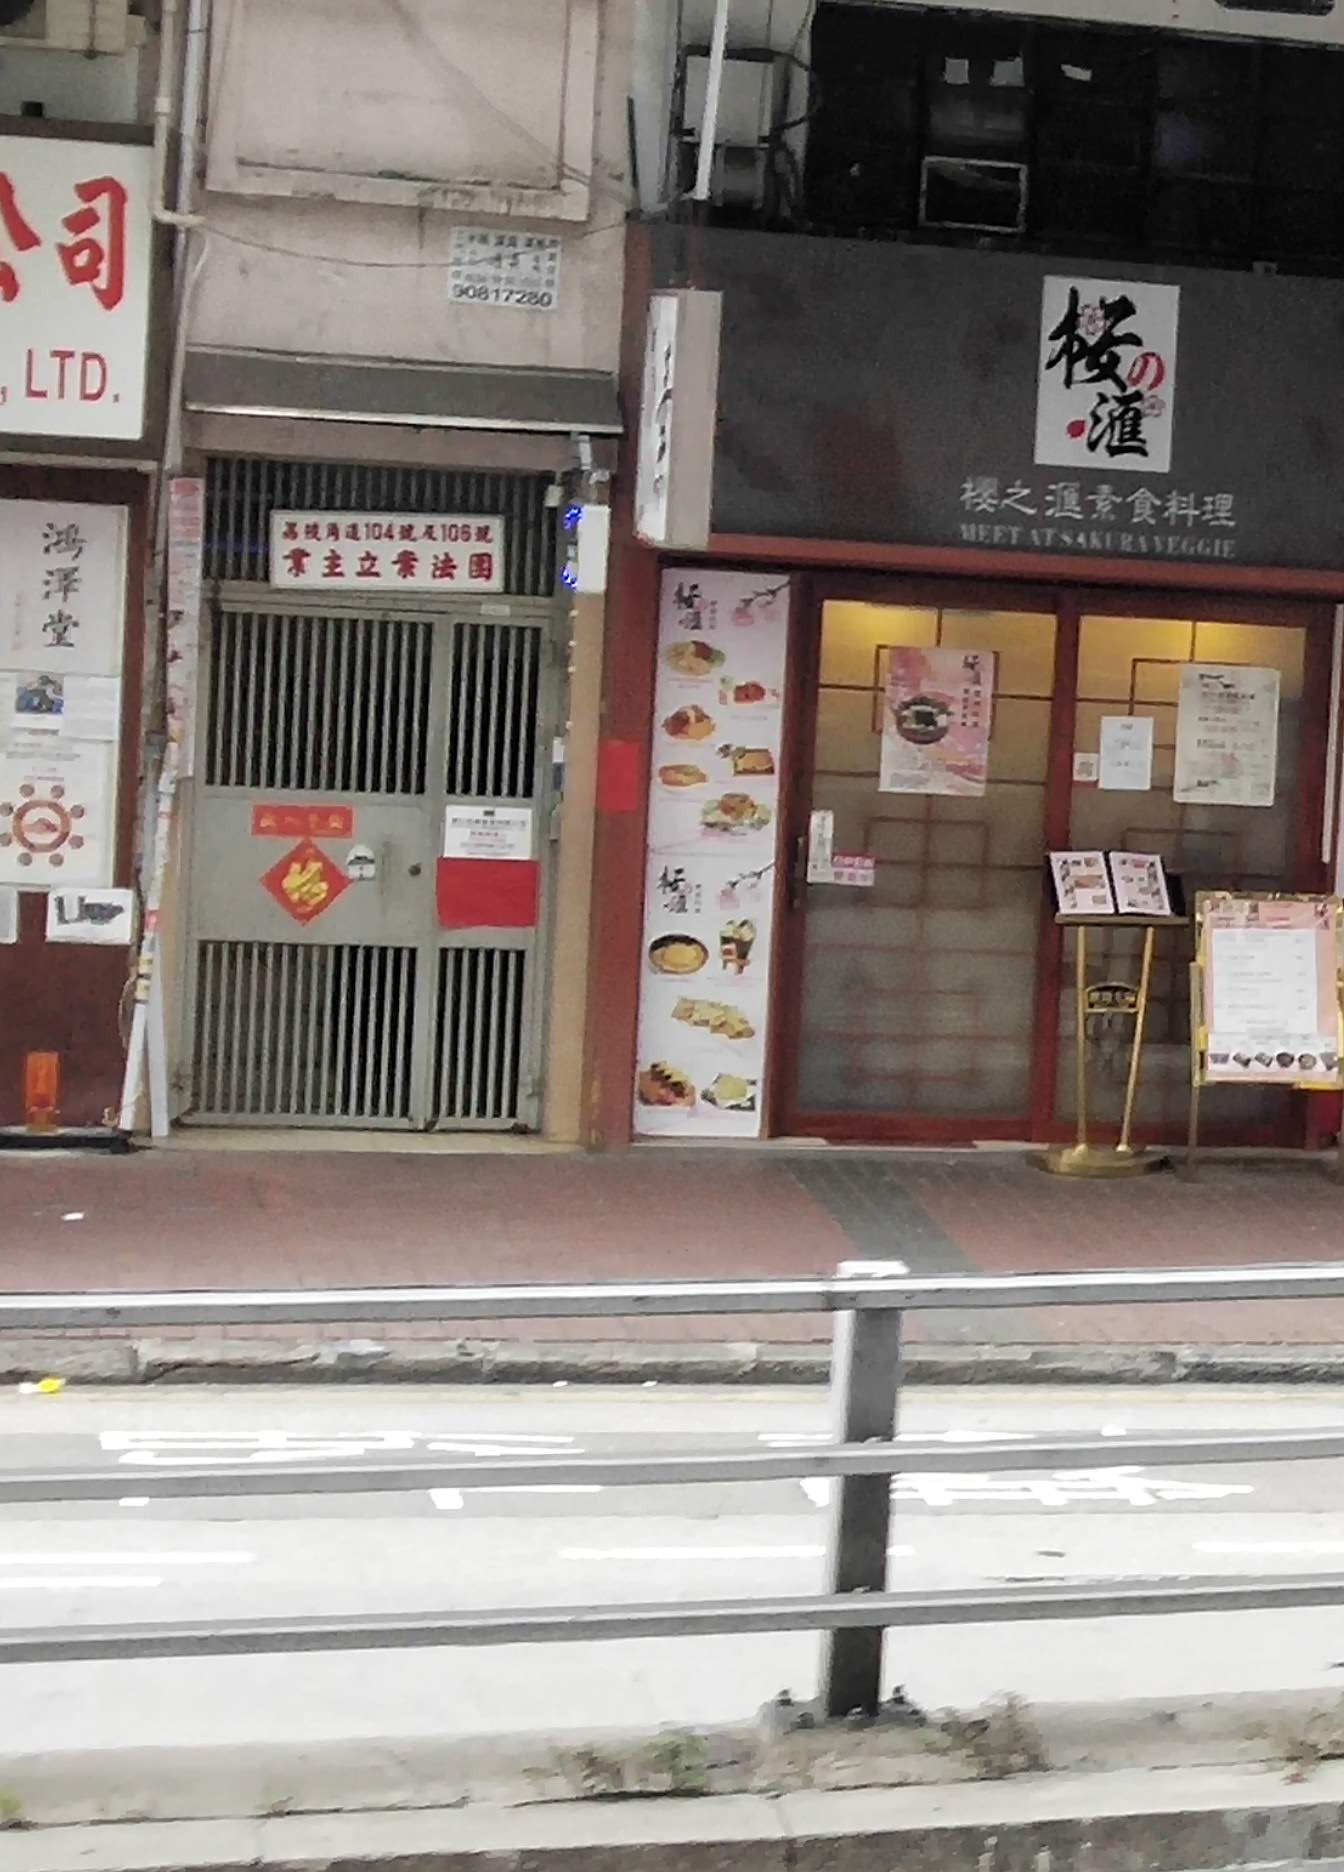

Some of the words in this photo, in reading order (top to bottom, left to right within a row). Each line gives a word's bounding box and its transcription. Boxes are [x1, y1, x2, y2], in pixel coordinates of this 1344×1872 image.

[25, 348, 120, 402] LTD.
[959, 523, 1022, 546] MEET
[1150, 533, 1236, 558] VEGGIE
[282, 547, 493, 581] 業主立案法團
